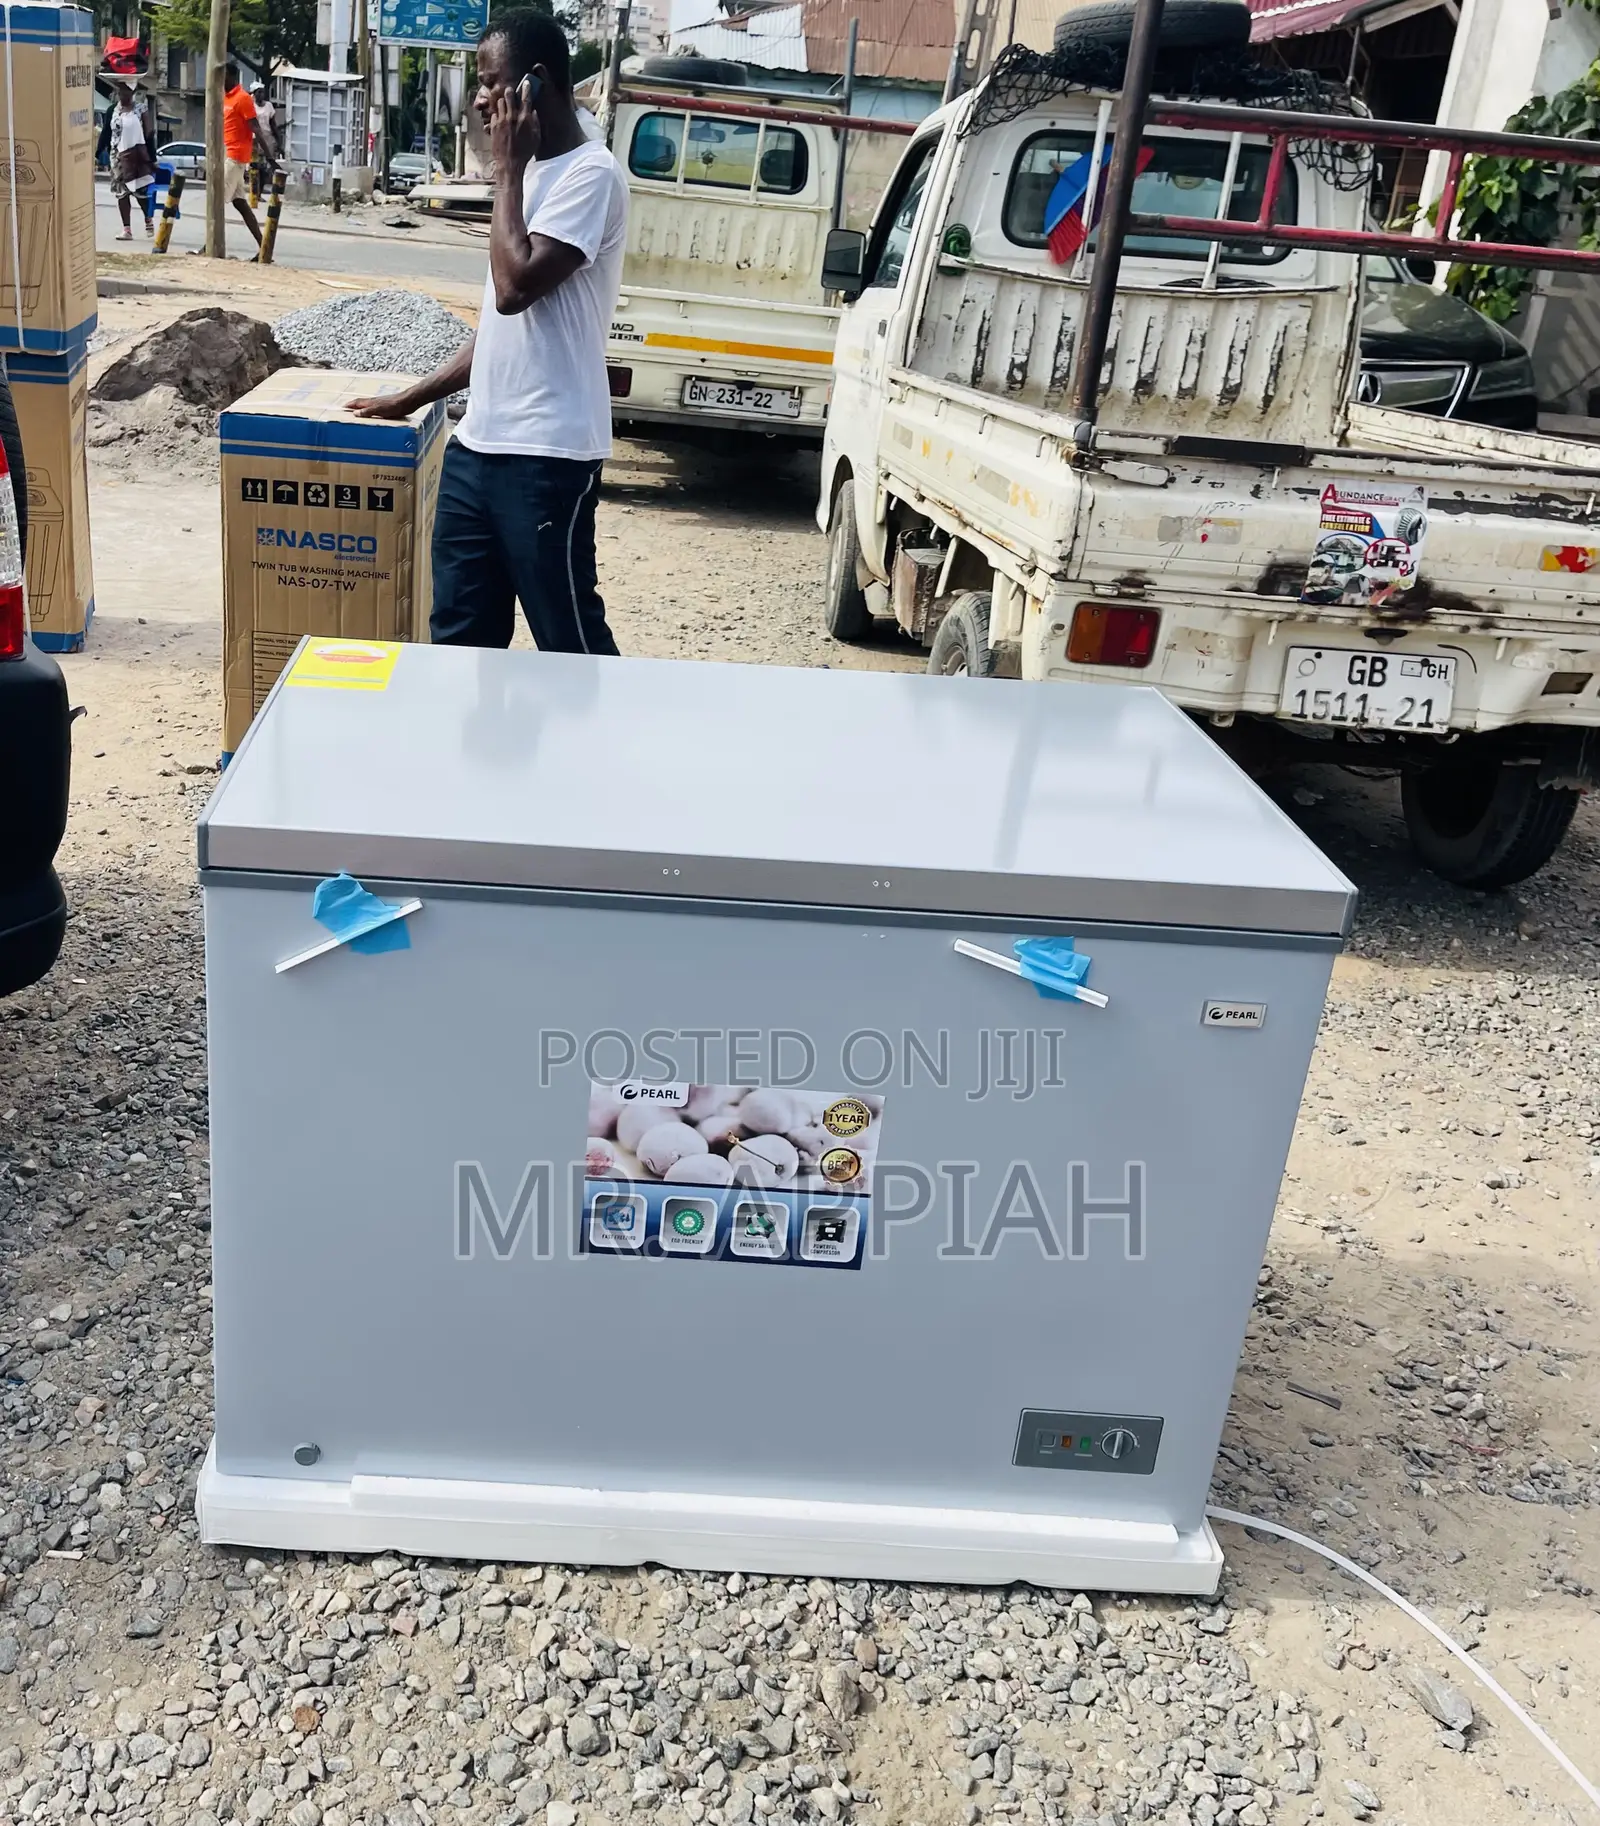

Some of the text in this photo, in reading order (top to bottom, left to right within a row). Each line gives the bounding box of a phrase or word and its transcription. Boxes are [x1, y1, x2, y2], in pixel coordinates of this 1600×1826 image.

[689, 384, 773, 409] GN 231-22
[788, 402, 799, 410] GH
[342, 487, 351, 500] 3
[276, 528, 377, 555] NASCO
[334, 552, 376, 563] electronics
[252, 561, 390, 580] TWIN TUB WASHING MACHINE
[277, 575, 357, 591] NAS-07-TW
[1348, 655, 1388, 687] GB
[1426, 663, 1449, 680] GH
[1225, 1010, 1258, 1020] PEARL
[640, 1088, 681, 1101] PEARL
[828, 1113, 865, 1124] 1 YEAR
[827, 1160, 855, 1172] BEST
